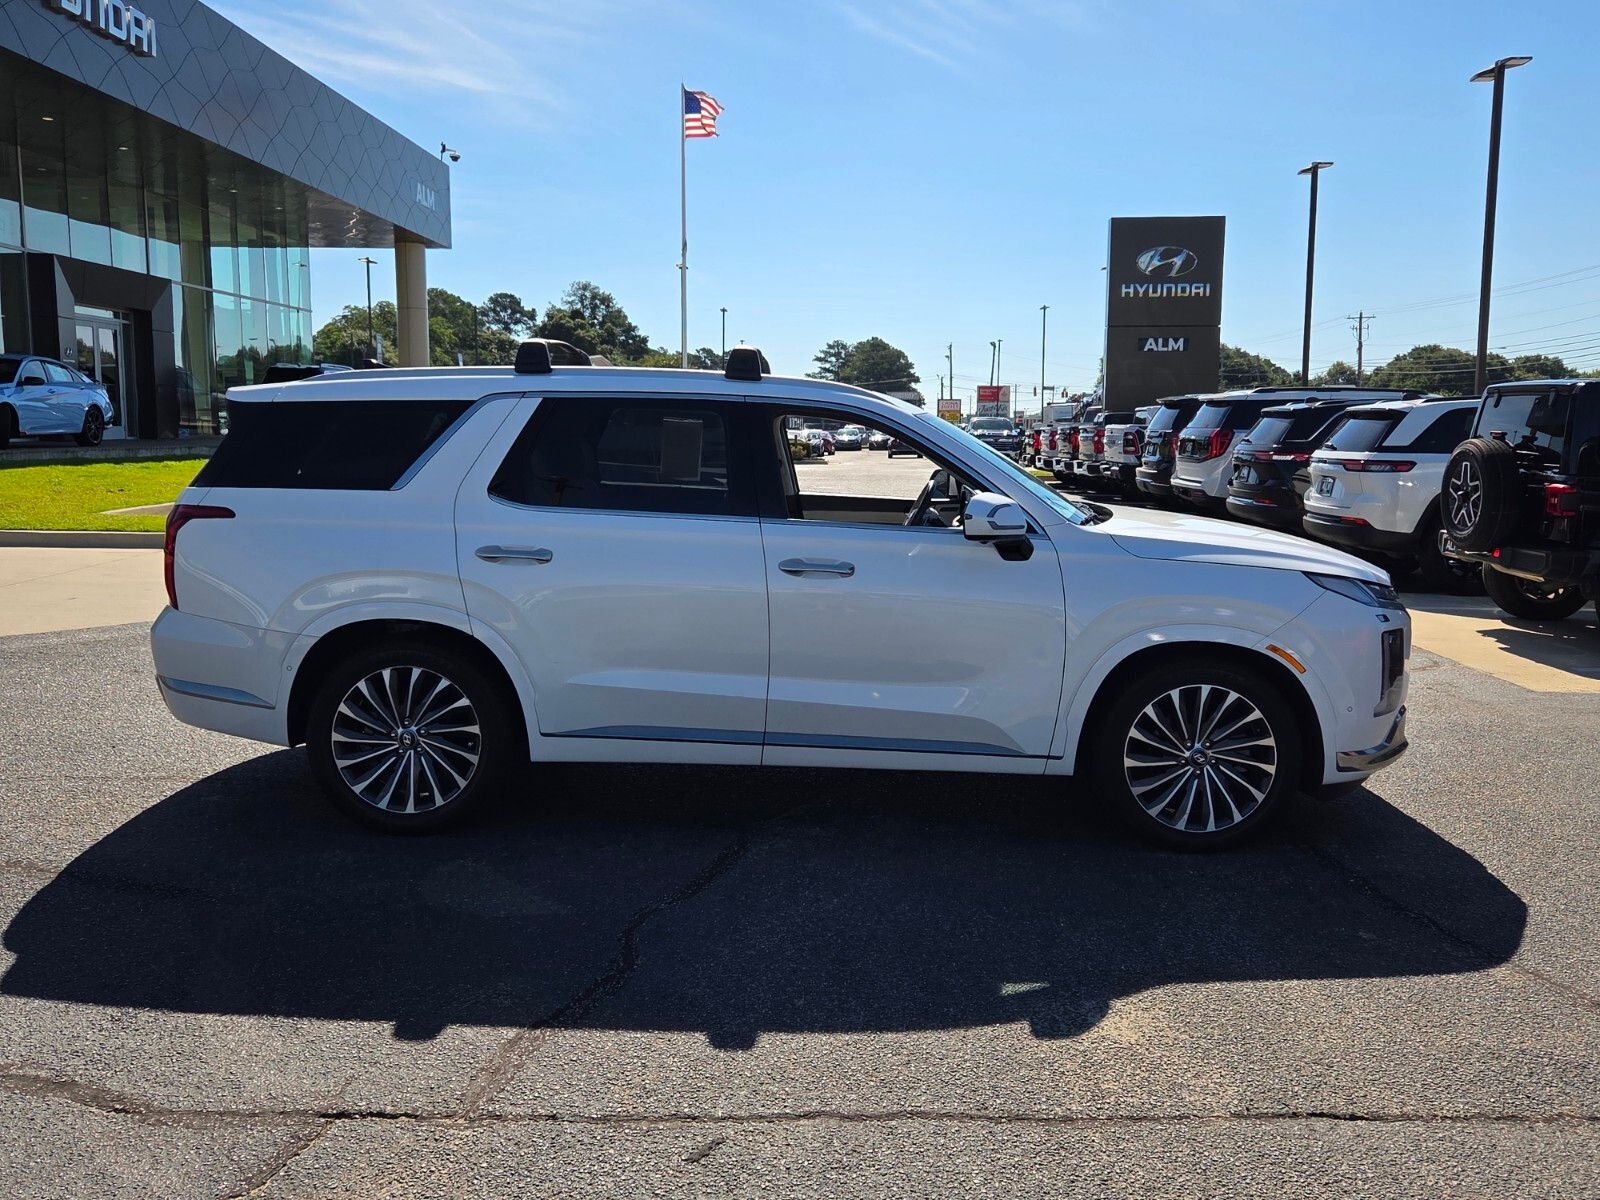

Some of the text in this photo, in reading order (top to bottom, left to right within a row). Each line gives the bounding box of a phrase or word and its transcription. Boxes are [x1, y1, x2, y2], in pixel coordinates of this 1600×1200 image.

[417, 182, 435, 211] ALM
[1121, 283, 1210, 298] HYUNDAI
[1144, 337, 1184, 352] ALM
